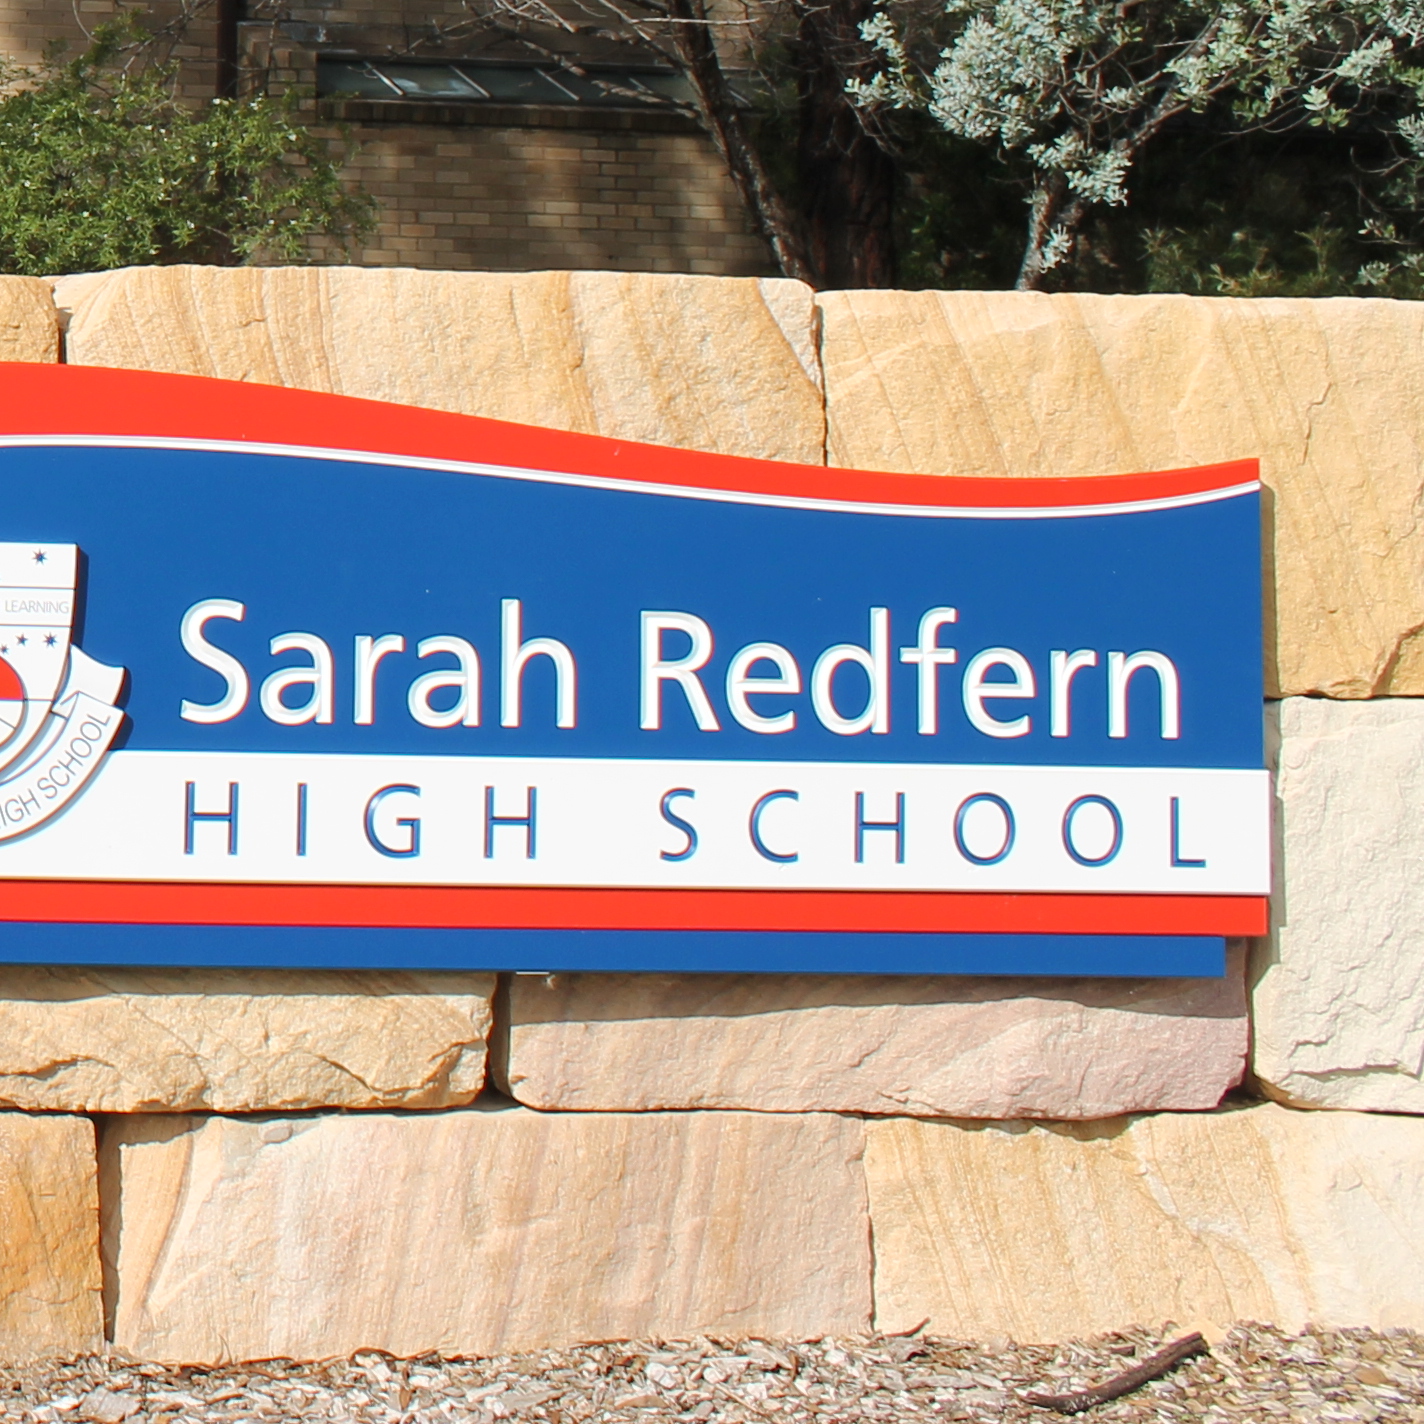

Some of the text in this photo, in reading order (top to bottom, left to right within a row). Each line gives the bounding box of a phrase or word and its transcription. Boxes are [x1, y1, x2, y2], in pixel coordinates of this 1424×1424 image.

[5, 599, 70, 614] LEARNING
[180, 599, 1180, 741] Sarah Redfern
[36, 711, 111, 800] SCHOOL
[184, 782, 1208, 869] HIGH SCHOOL
